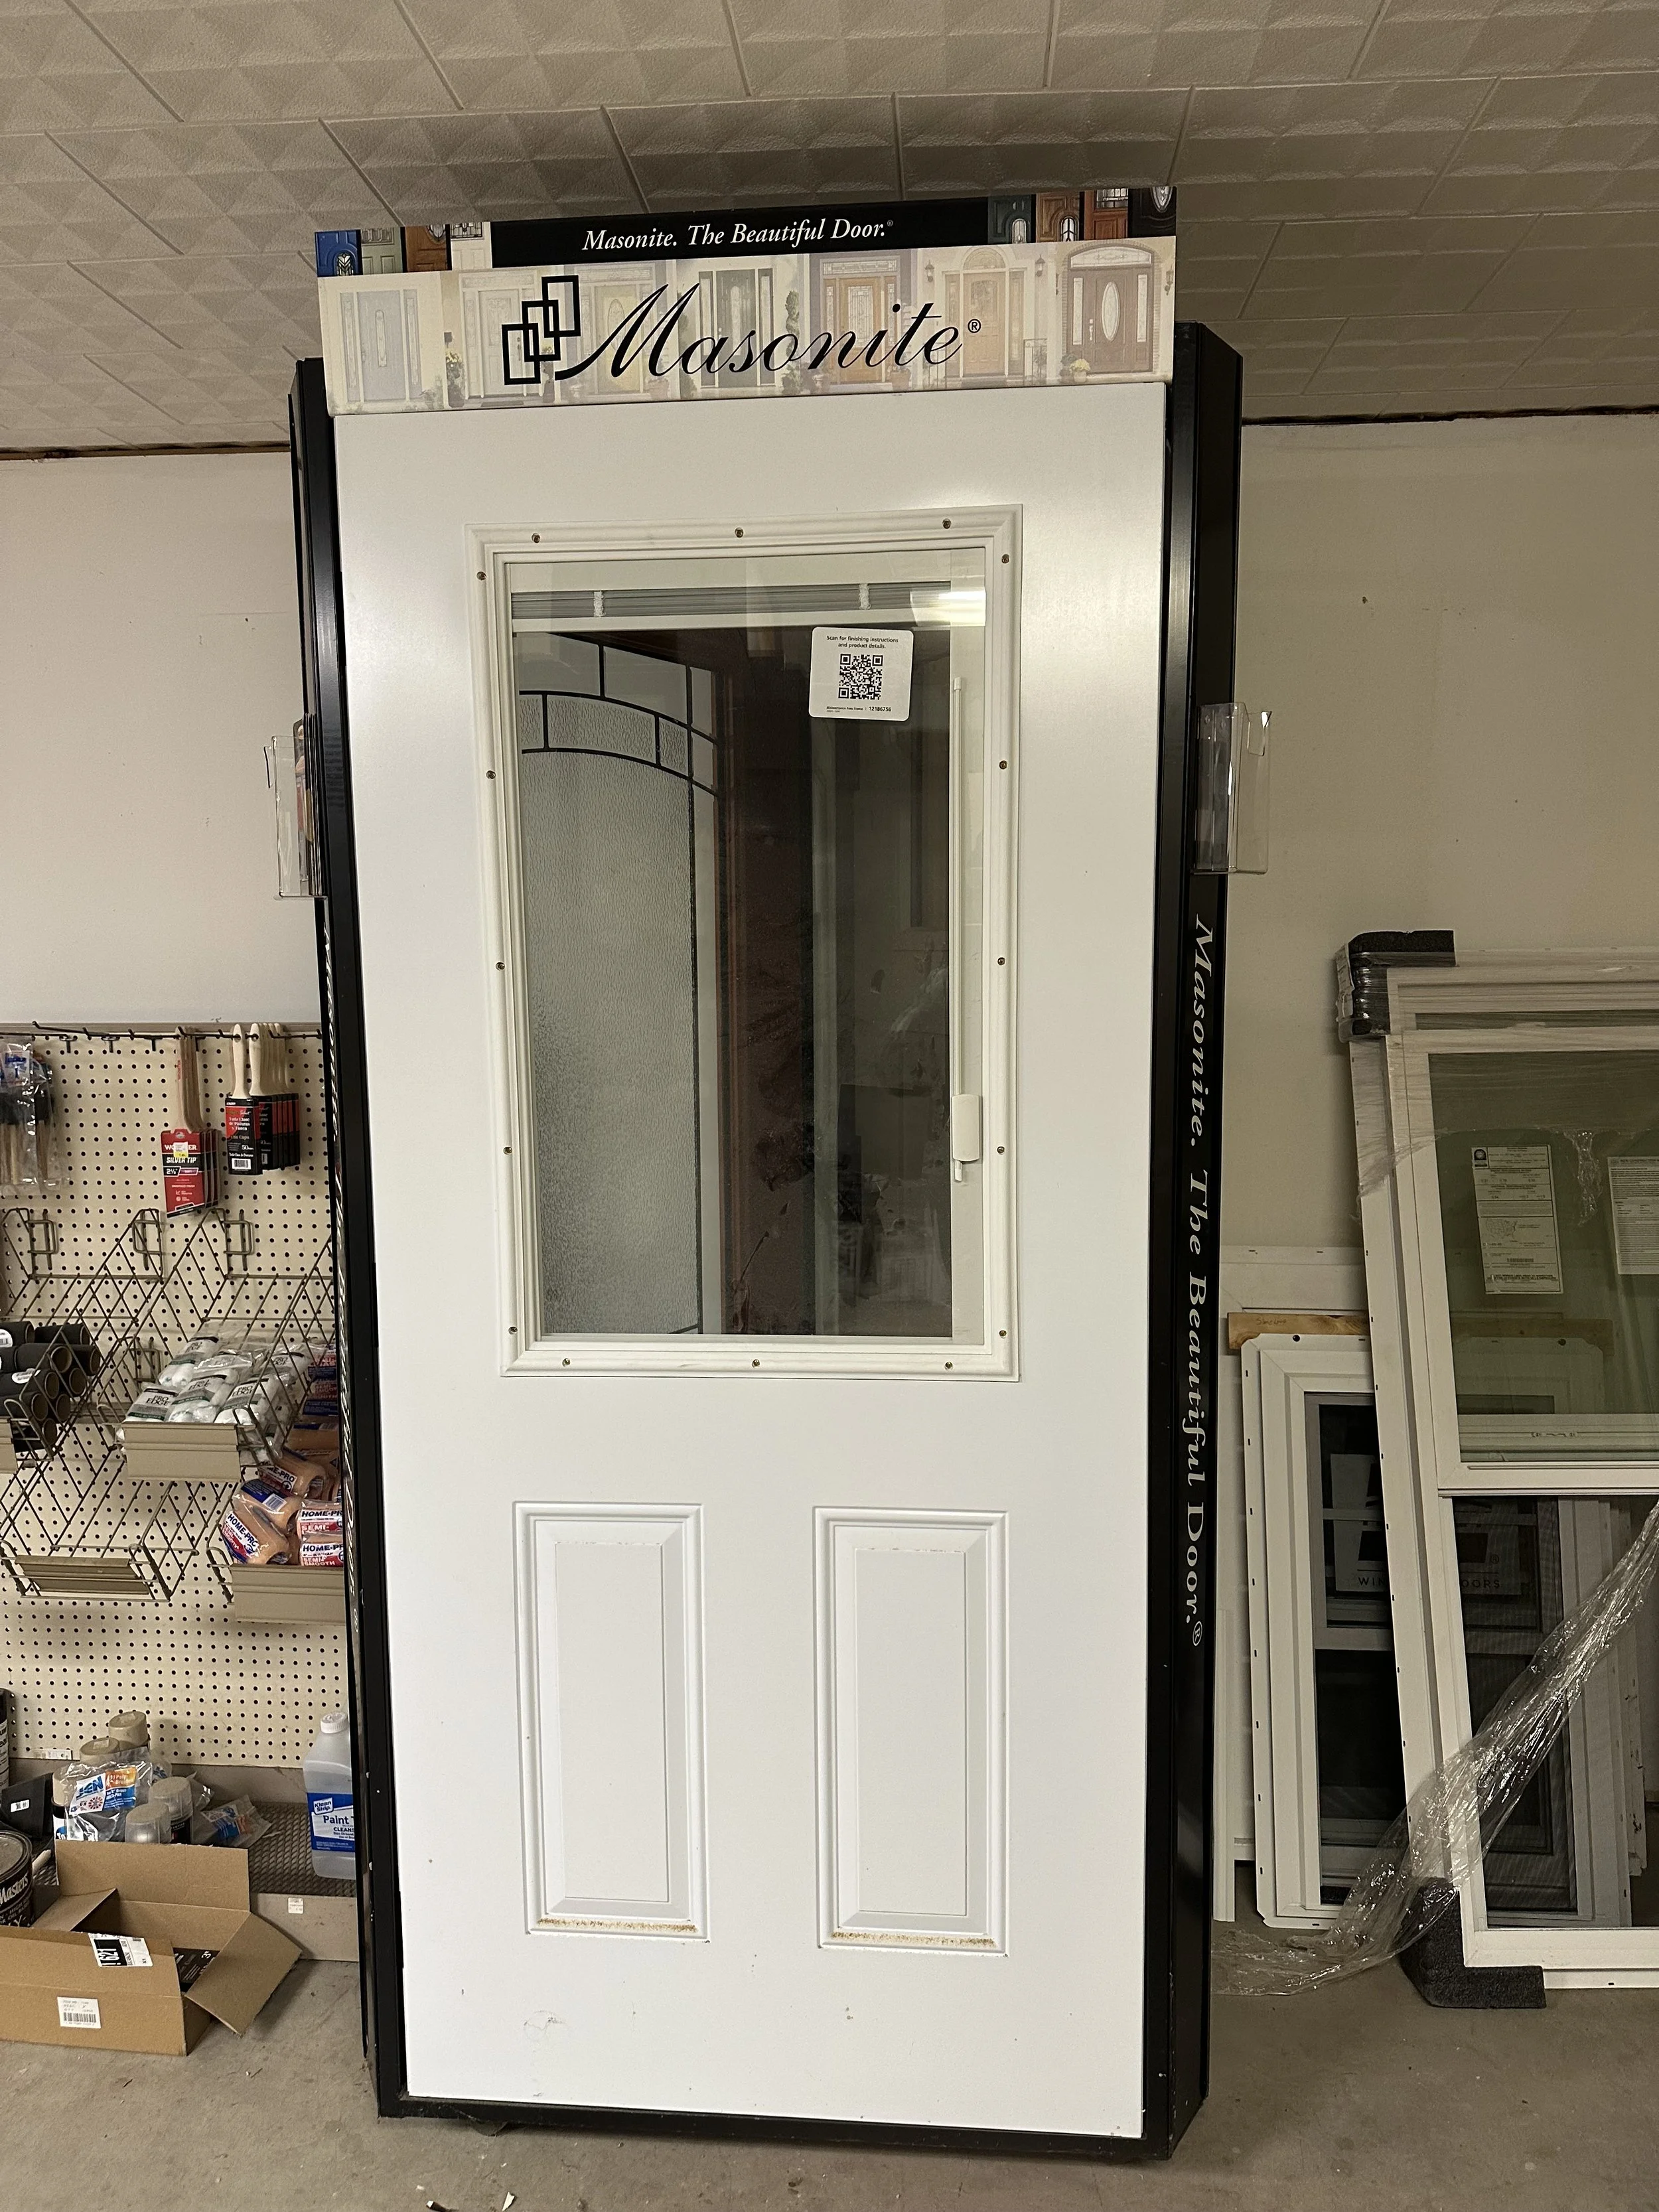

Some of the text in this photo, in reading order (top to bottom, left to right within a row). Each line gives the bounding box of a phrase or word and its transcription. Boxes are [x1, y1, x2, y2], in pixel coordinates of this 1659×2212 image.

[582, 228, 677, 250] Masonite.
[687, 224, 725, 246] The
[731, 218, 824, 248] Beautiful
[1191, 913, 1214, 1147] Masonite.
[1189, 1169, 1208, 1255] The
[1182, 1271, 1206, 1487] Beautiful
[323, 1815, 350, 1824] Paint
